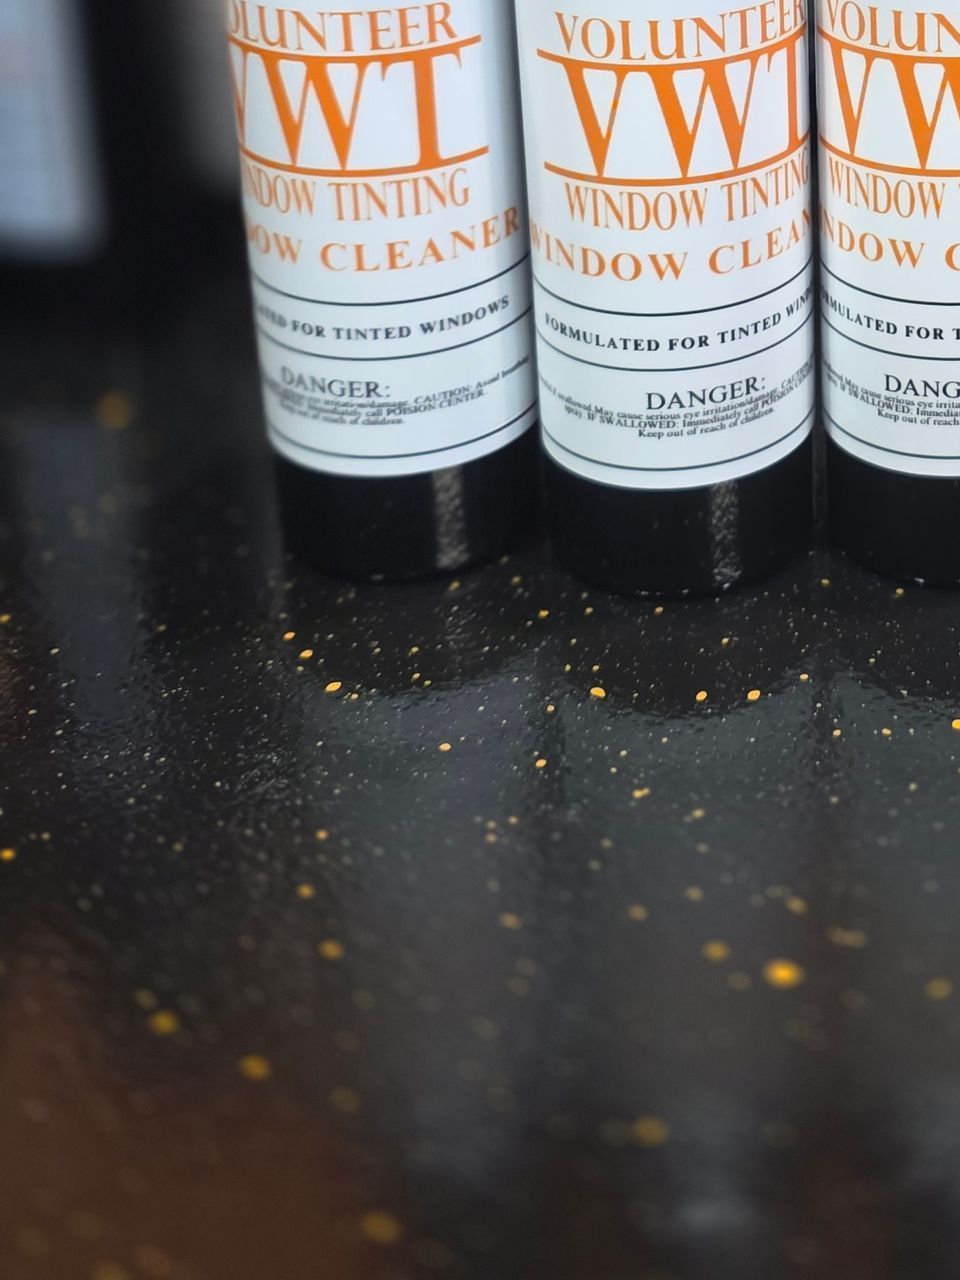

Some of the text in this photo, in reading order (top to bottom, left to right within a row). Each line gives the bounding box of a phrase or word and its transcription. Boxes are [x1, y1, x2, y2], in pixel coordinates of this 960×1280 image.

[328, 168, 470, 221] TINTING
[564, 146, 809, 231] WINDOW TINTING
[828, 156, 946, 220] WINDOW
[319, 205, 521, 272] CLEANER
[530, 218, 688, 281] WINDOW
[291, 319, 327, 338] FOR
[333, 324, 411, 341] TINTED
[419, 295, 509, 335] WINDOWS
[545, 312, 660, 352] FORMULATED
[668, 335, 710, 352] FOR
[717, 312, 781, 345] TINTED
[904, 325, 945, 340] FOR
[281, 365, 391, 399] DANGER:
[645, 376, 766, 410] DANGER:
[645, 411, 681, 420] serious
[683, 410, 700, 420] eye
[877, 408, 900, 423] Keep
[901, 415, 918, 424] out
[920, 417, 932, 426] of
[933, 418, 960, 427] reach
[884, 395, 915, 407] serious
[917, 400, 934, 410] eye
[638, 429, 665, 440] Keep
[667, 429, 684, 438] out
[687, 426, 699, 436] of
[700, 421, 726, 434] reach
